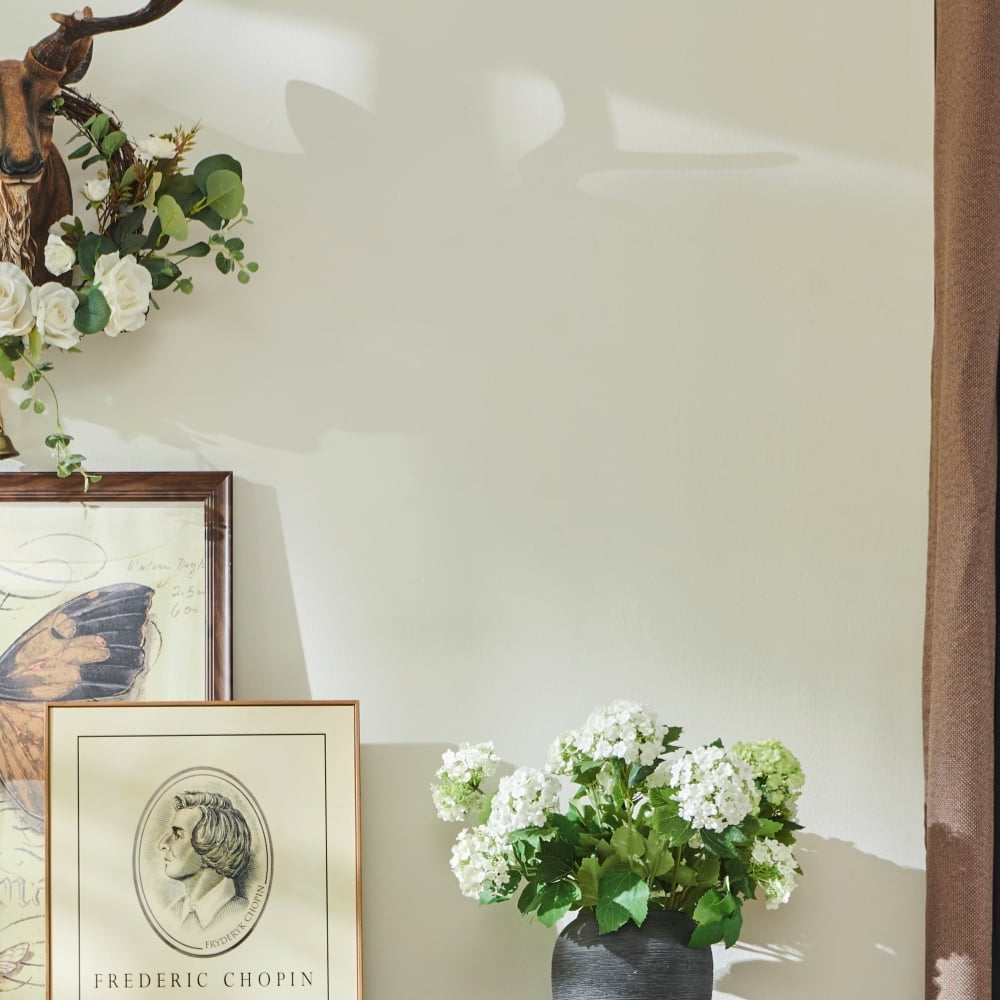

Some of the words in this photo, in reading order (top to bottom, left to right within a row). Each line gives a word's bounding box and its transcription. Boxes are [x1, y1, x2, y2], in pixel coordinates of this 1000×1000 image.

[204, 921, 247, 949] FRYDERYK
[244, 884, 265, 922] CHOPIN
[94, 972, 208, 989] FREDERIC
[223, 971, 315, 988] CHOPIN
